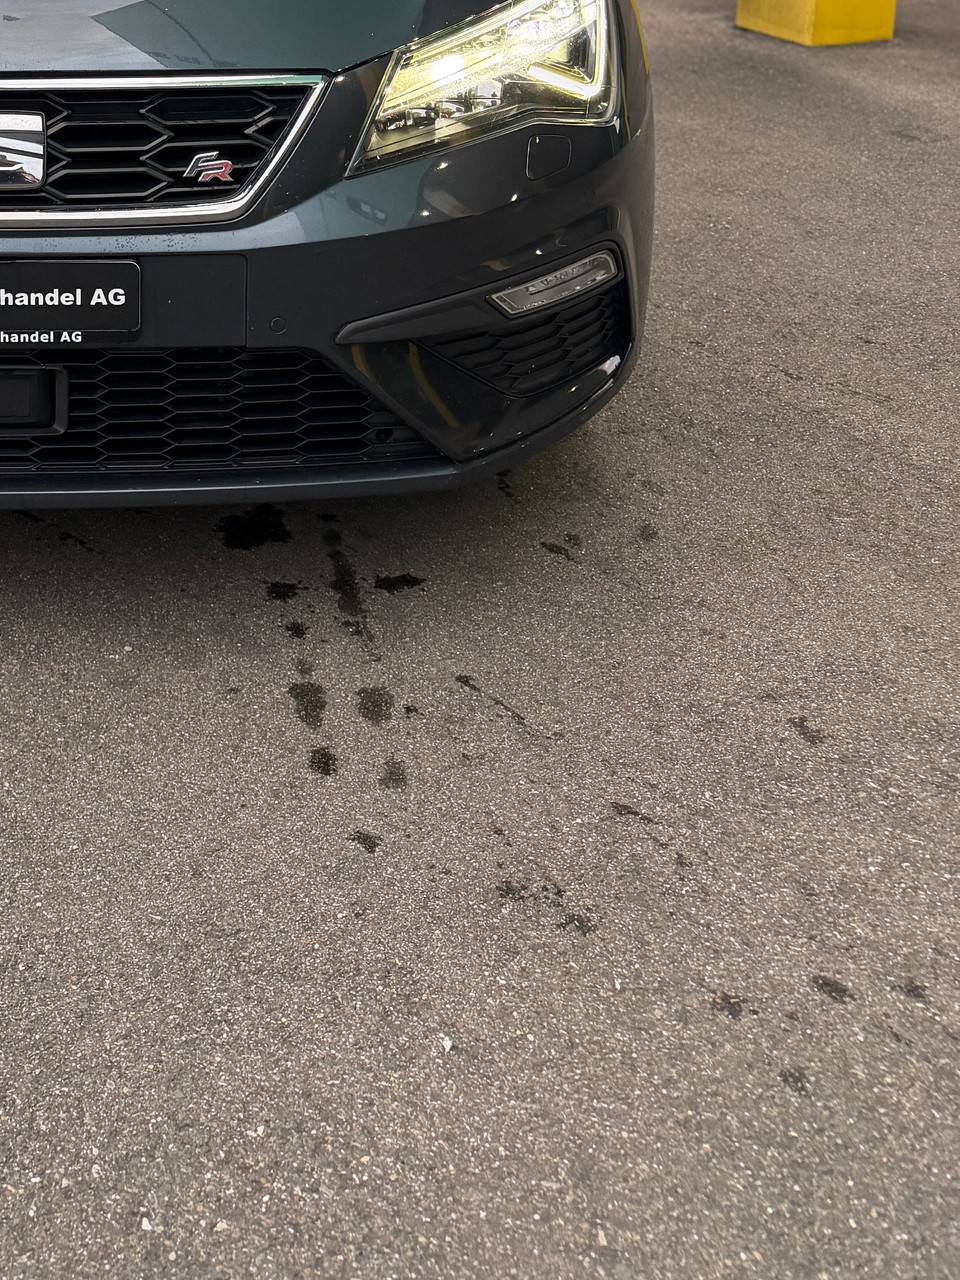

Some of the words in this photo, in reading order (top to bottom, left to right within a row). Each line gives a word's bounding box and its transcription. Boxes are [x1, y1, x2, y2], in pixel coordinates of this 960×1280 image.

[183, 151, 234, 182] FR
[90, 288, 126, 306] AG
[59, 331, 82, 343] AG
